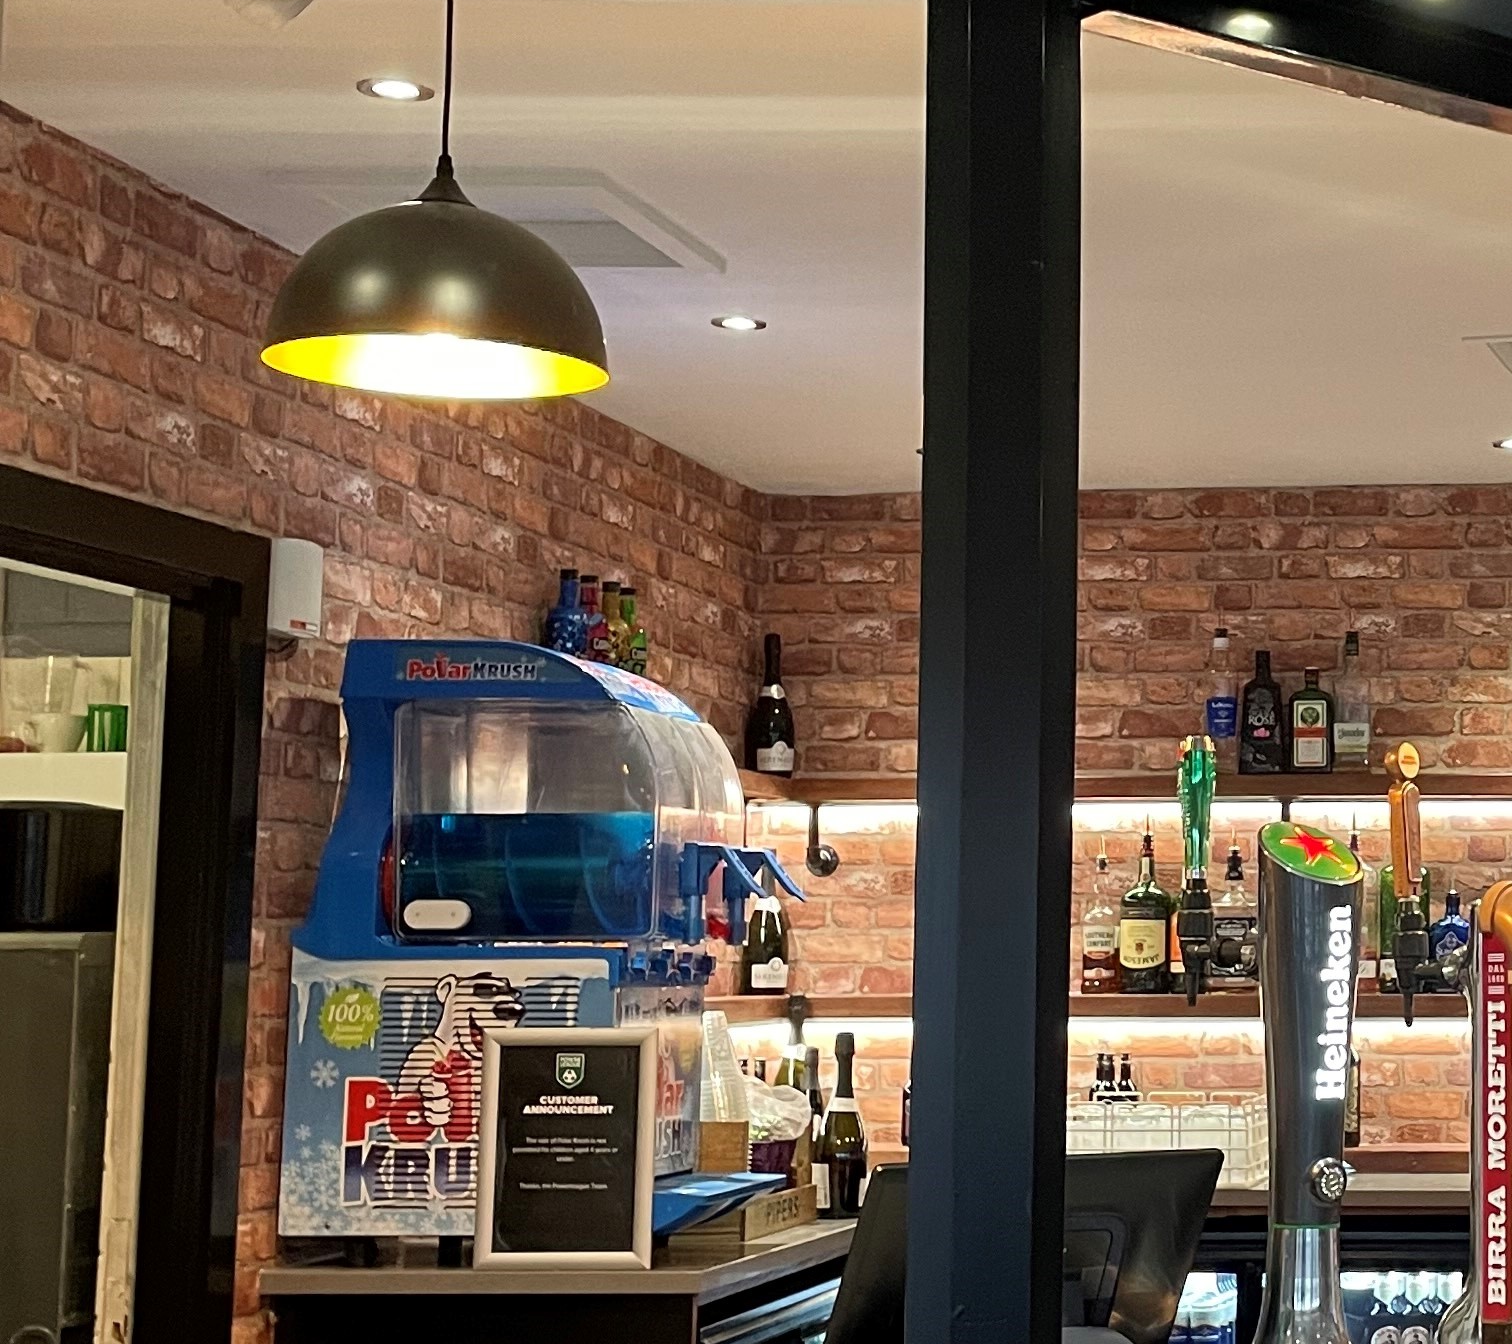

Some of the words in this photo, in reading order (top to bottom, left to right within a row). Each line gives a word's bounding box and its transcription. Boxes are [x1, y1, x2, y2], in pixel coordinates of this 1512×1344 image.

[328, 1003, 374, 1023] 100%
[1315, 903, 1352, 1101] Heineken
[539, 1095, 598, 1105] CUSTOMER
[1487, 999, 1506, 1171] MORETTI
[522, 1105, 615, 1115] ANNOUNCEMENT
[342, 1143, 479, 1204] KRU
[765, 1194, 800, 1225] PIPERS
[1487, 1184, 1507, 1306] BIRRA
